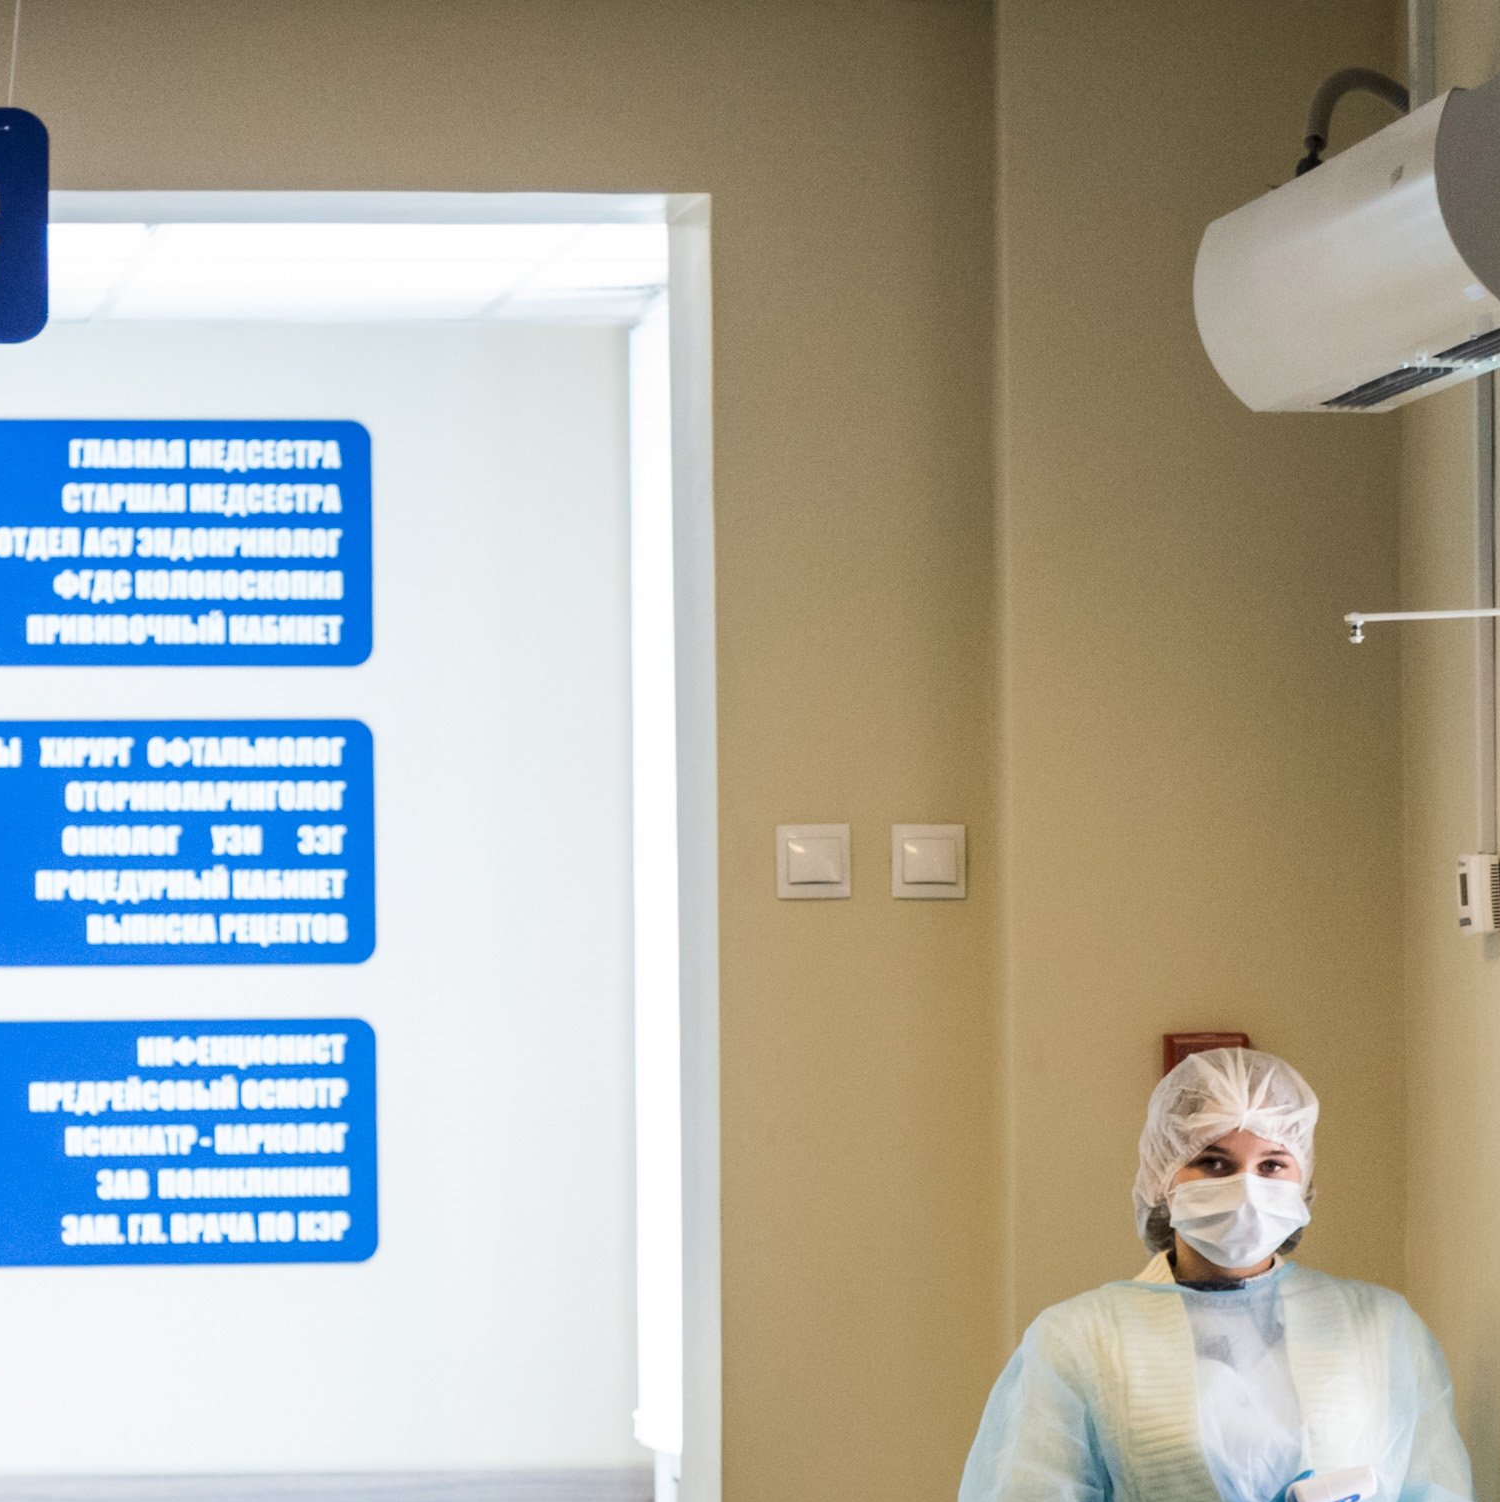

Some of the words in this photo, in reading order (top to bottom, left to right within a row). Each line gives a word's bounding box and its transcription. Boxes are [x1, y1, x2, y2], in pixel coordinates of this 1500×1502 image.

[69, 439, 186, 468] ГЛАВНАЯ
[190, 439, 342, 472] МЕДСЕСТРА
[61, 483, 186, 513] СТАРШАЯ
[190, 484, 342, 517] МЕДСЕСТРА
[83, 527, 134, 557] АСУ
[137, 527, 342, 561] ЭНДОКРИНОЛОГ
[53, 570, 132, 603] ФГДС
[135, 570, 343, 600] КОЛОНОСКОПИЯ
[27, 610, 226, 644] ПРИВИВОЧНЫЙ
[229, 615, 342, 644] КАБИНЕТ
[39, 737, 134, 767] ХИРУРГ
[148, 737, 346, 767] ОФТАЛЬМОЛОГ
[65, 781, 347, 811] ОТОРИНОЛАРИНГОЛОГ
[62, 825, 181, 856] ОНКОЛОГ
[211, 825, 263, 855] УЗИ
[35, 865, 229, 903] ПРОЦЕДУРНЫЙ
[233, 869, 347, 899] КАБИНЕТ
[87, 914, 217, 944] ВЫПИСКА
[220, 913, 347, 947] РЕЦЕПТОВ
[137, 1034, 347, 1068] ИНФЕКЦИОНИСТ
[29, 1075, 238, 1115] ПРЕДРЕЙСОВЫЙ
[241, 1078, 348, 1109] ОСМОТР
[65, 1124, 198, 1157] ПСИХИАТР
[215, 1123, 349, 1154] НАРКОЛОГ
[158, 1166, 350, 1198] ПОЛИКЛИНИКИ
[61, 1214, 125, 1245] ЗАМ.
[128, 1214, 168, 1244] ГЛ.
[170, 1212, 256, 1243] ВРАЧА
[258, 1212, 295, 1242] ПО
